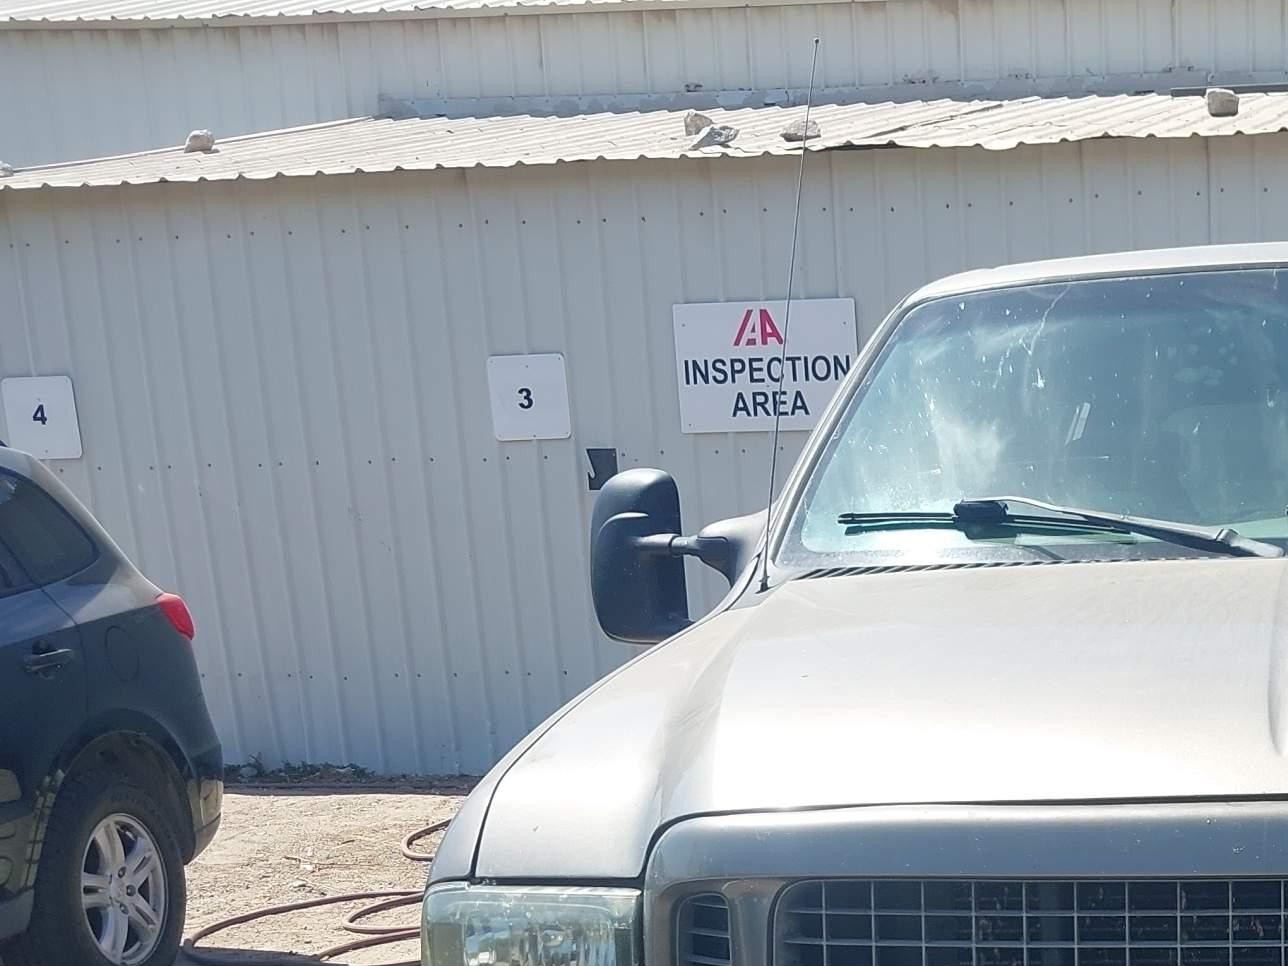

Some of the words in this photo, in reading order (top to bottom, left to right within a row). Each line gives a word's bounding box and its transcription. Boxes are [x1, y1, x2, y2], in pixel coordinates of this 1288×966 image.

[683, 354, 851, 385] INSPECTION
[517, 387, 534, 410] 3
[731, 390, 811, 418] AREA
[32, 403, 48, 426] 4
